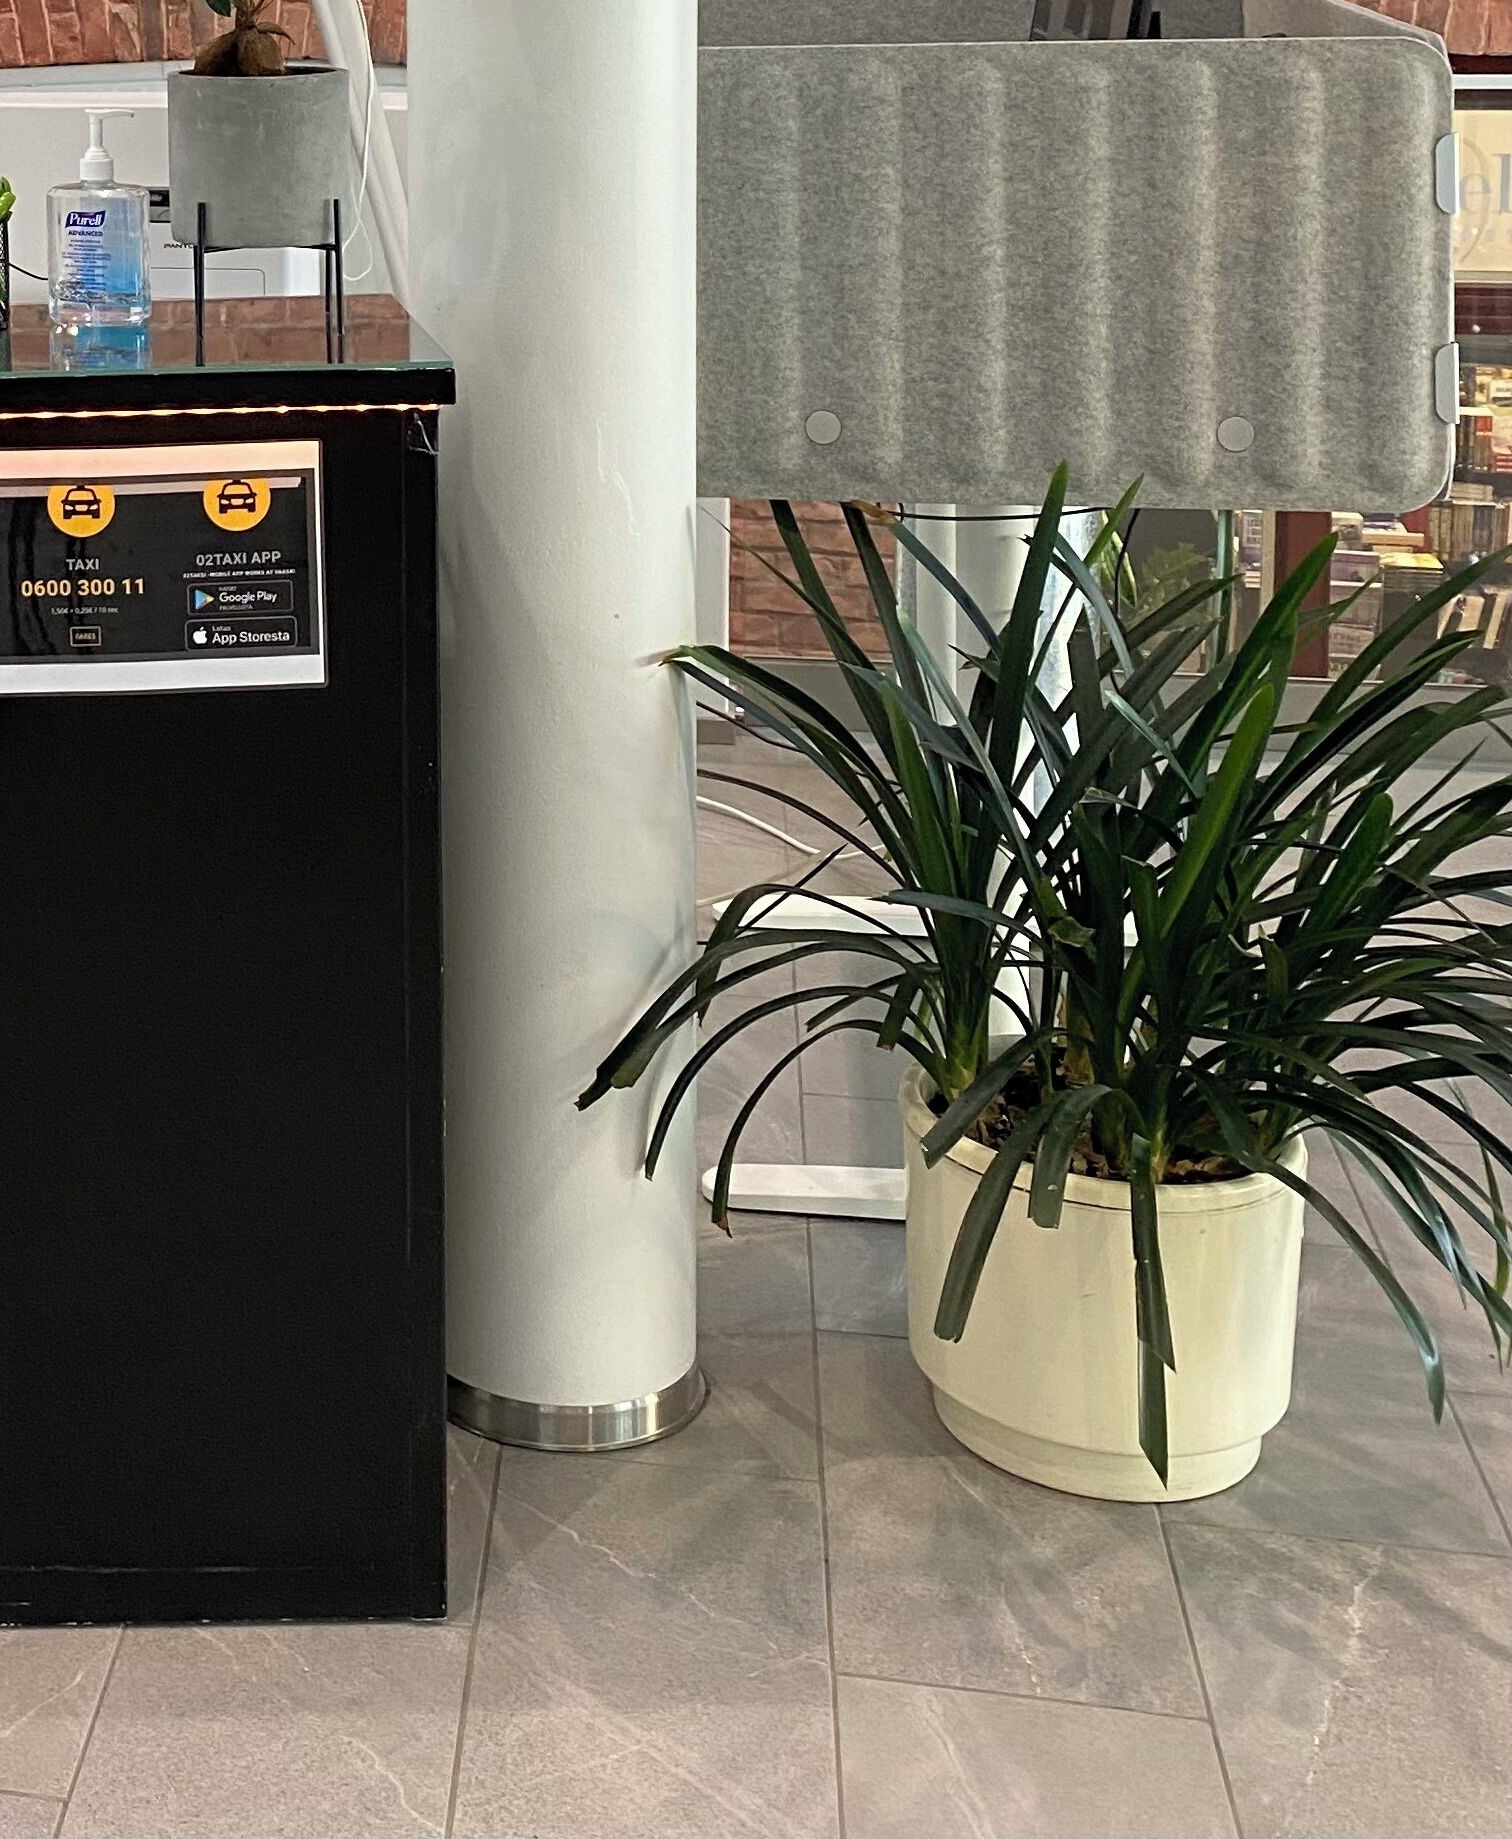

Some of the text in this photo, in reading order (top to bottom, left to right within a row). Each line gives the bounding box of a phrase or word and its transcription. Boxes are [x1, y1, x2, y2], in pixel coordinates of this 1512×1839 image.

[69, 212, 103, 226] Purell
[65, 558, 100, 571] TAXI
[196, 550, 282, 567] 02TAXI APP
[21, 577, 144, 597] 0600 300 11
[219, 590, 277, 604] Google Play
[211, 630, 291, 646] App Storesta
